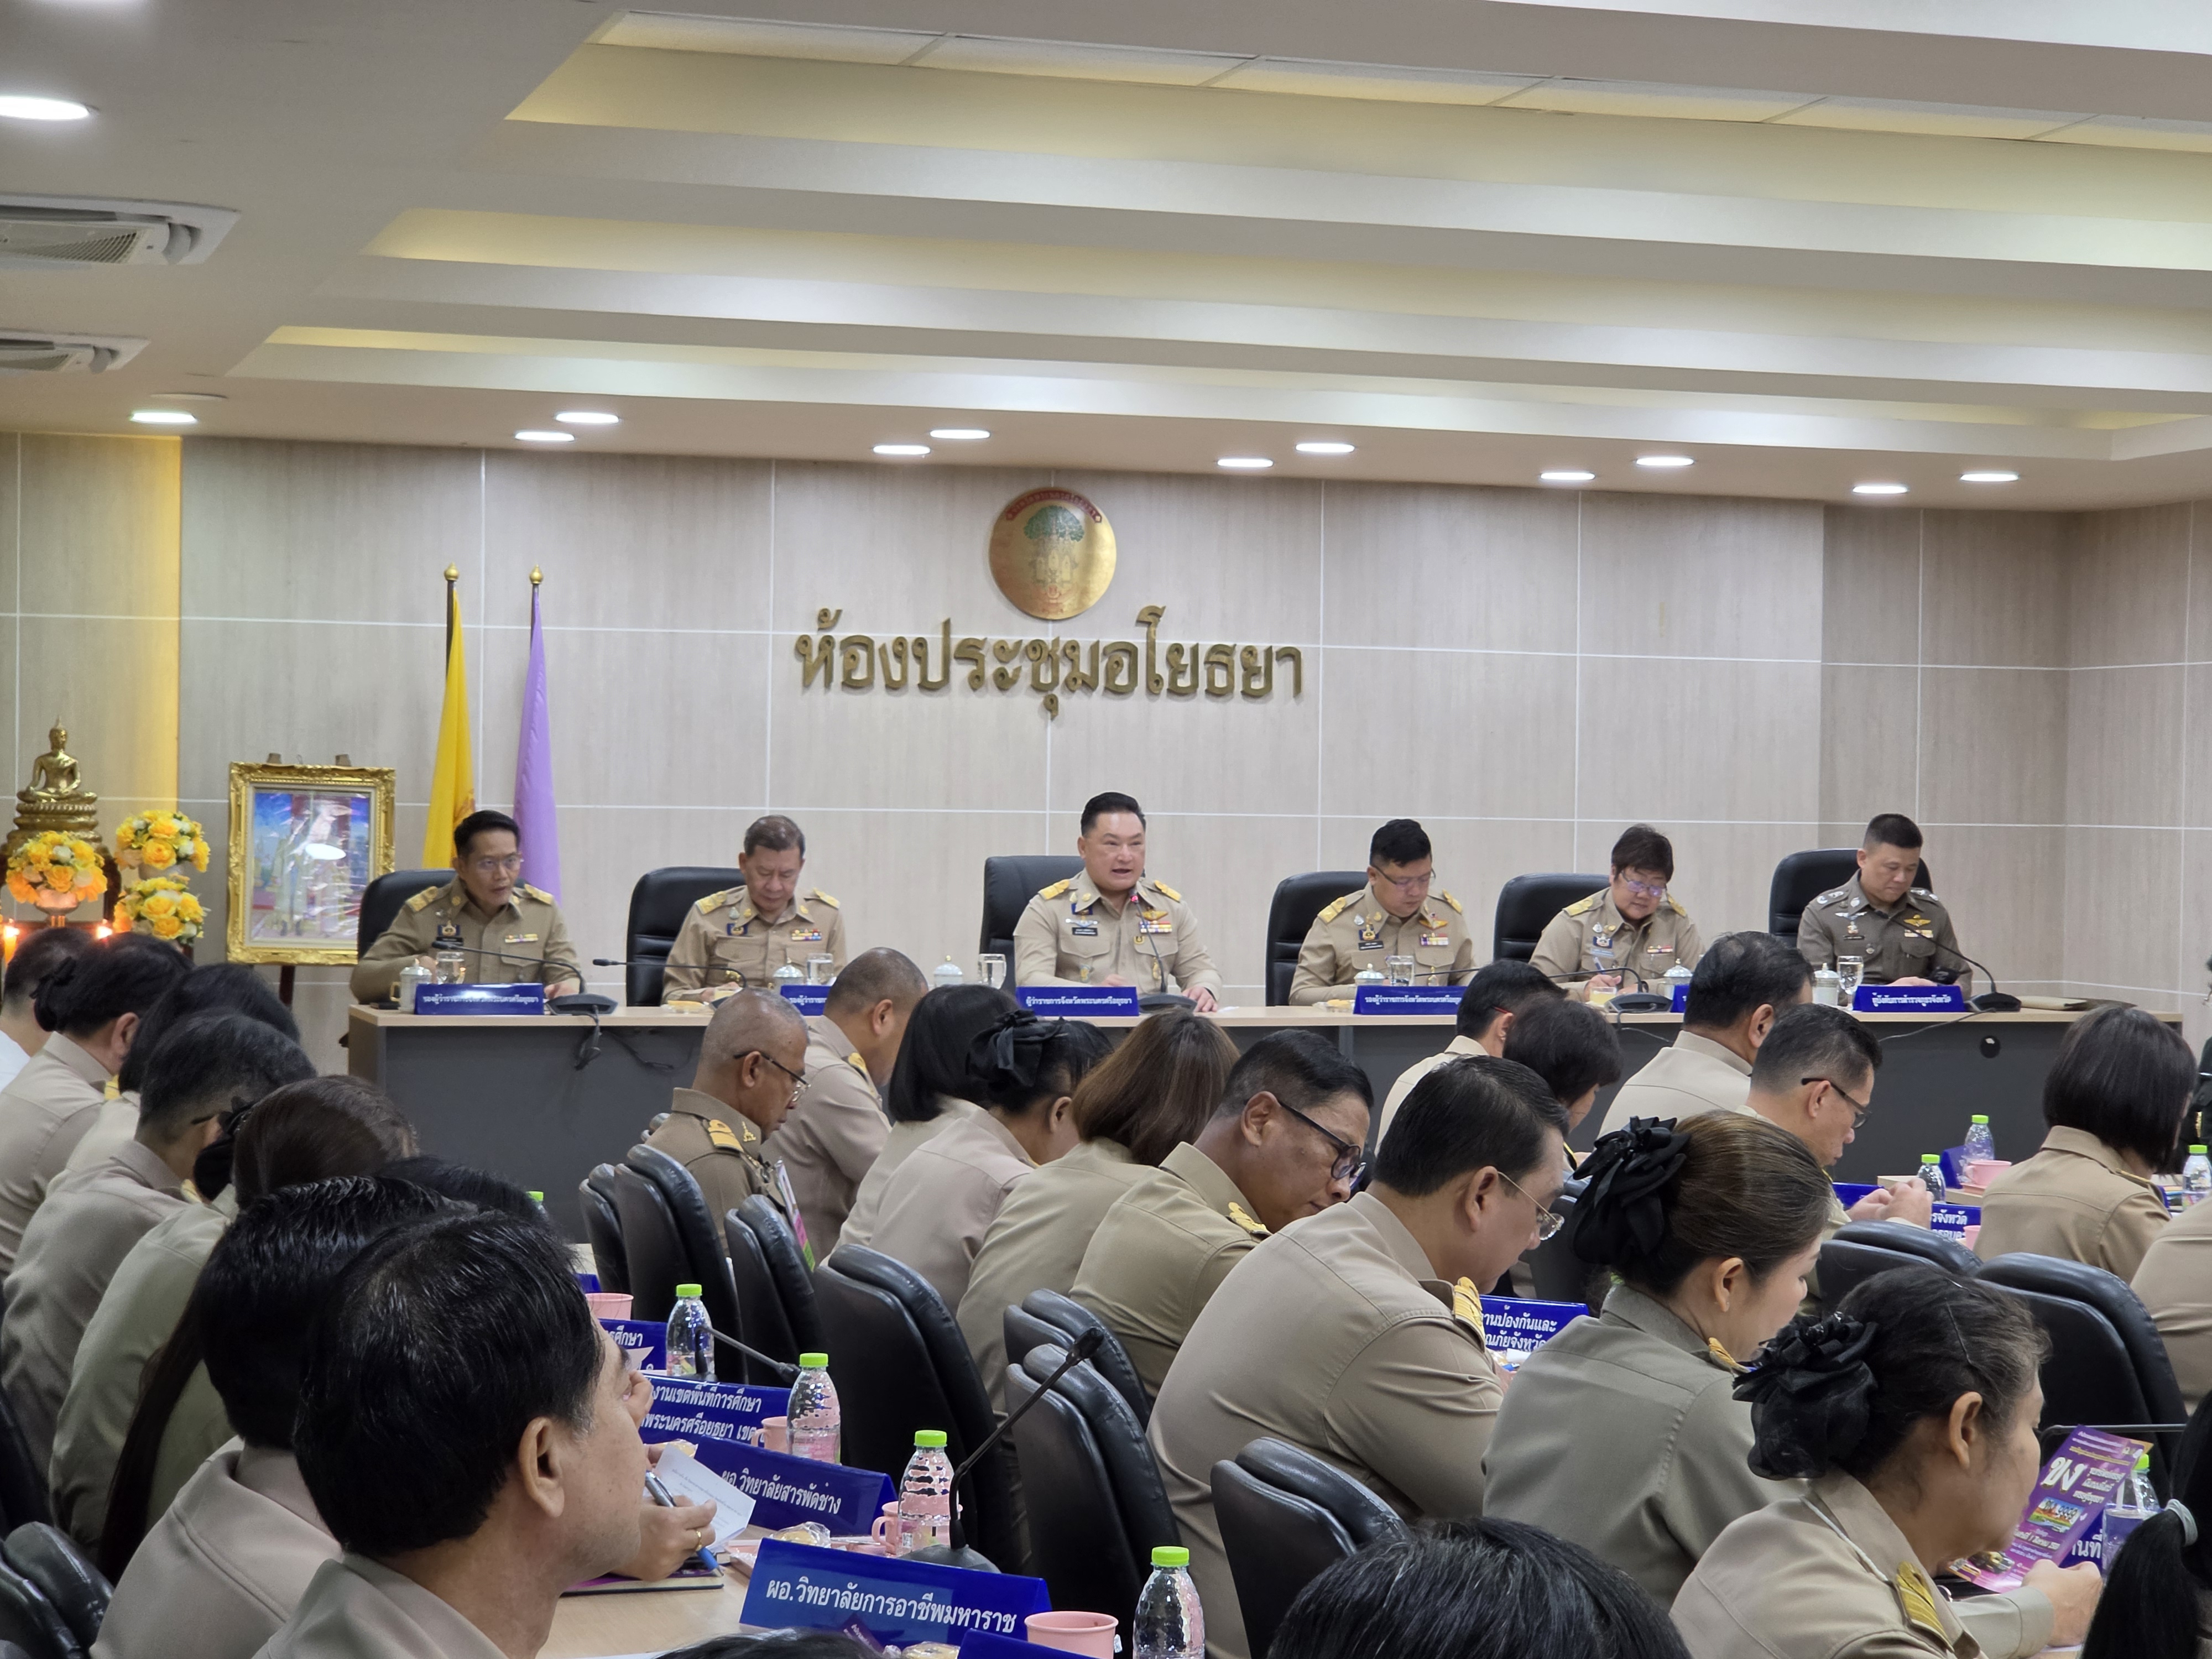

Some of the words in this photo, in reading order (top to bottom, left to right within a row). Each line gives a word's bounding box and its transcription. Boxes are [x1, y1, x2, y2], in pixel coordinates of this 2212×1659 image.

[795, 605, 1303, 720] ห้องประชุมอโยธยา
[1481, 1305, 1557, 1332] านป้องกันและ
